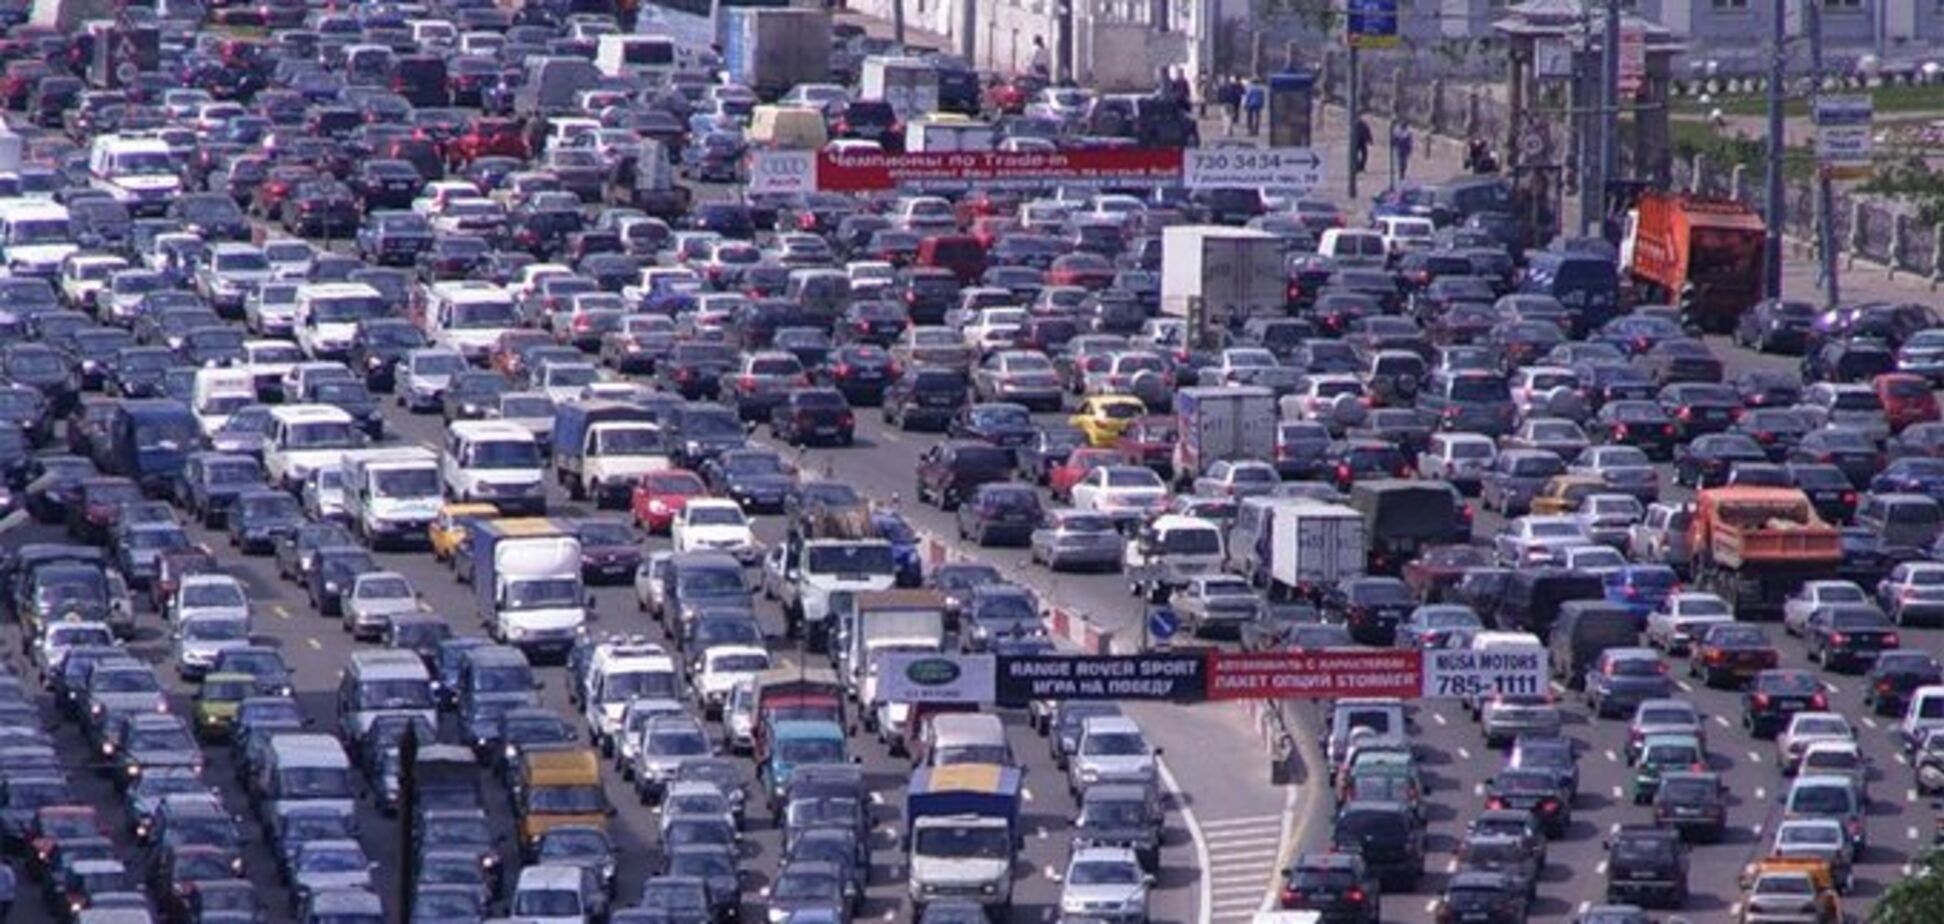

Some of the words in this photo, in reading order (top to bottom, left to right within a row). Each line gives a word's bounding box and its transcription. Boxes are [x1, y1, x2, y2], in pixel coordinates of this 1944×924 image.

[948, 155, 976, 168] по
[985, 153, 1069, 167] Trade-in
[1233, 153, 1281, 169] 3434
[1009, 660, 1071, 676] RANGE
[1075, 660, 1136, 676] ROVER
[1140, 660, 1199, 675] SPORT
[1479, 654, 1538, 670] MOTORS
[1032, 680, 1076, 694] ИГРА
[1080, 680, 1105, 694] НА
[1109, 679, 1174, 696] ПОБЕДУ
[1215, 674, 1268, 689] ПАКЕТ
[1272, 672, 1331, 690] ОПЦИЙ
[1436, 675, 1537, 694] 785-1111
